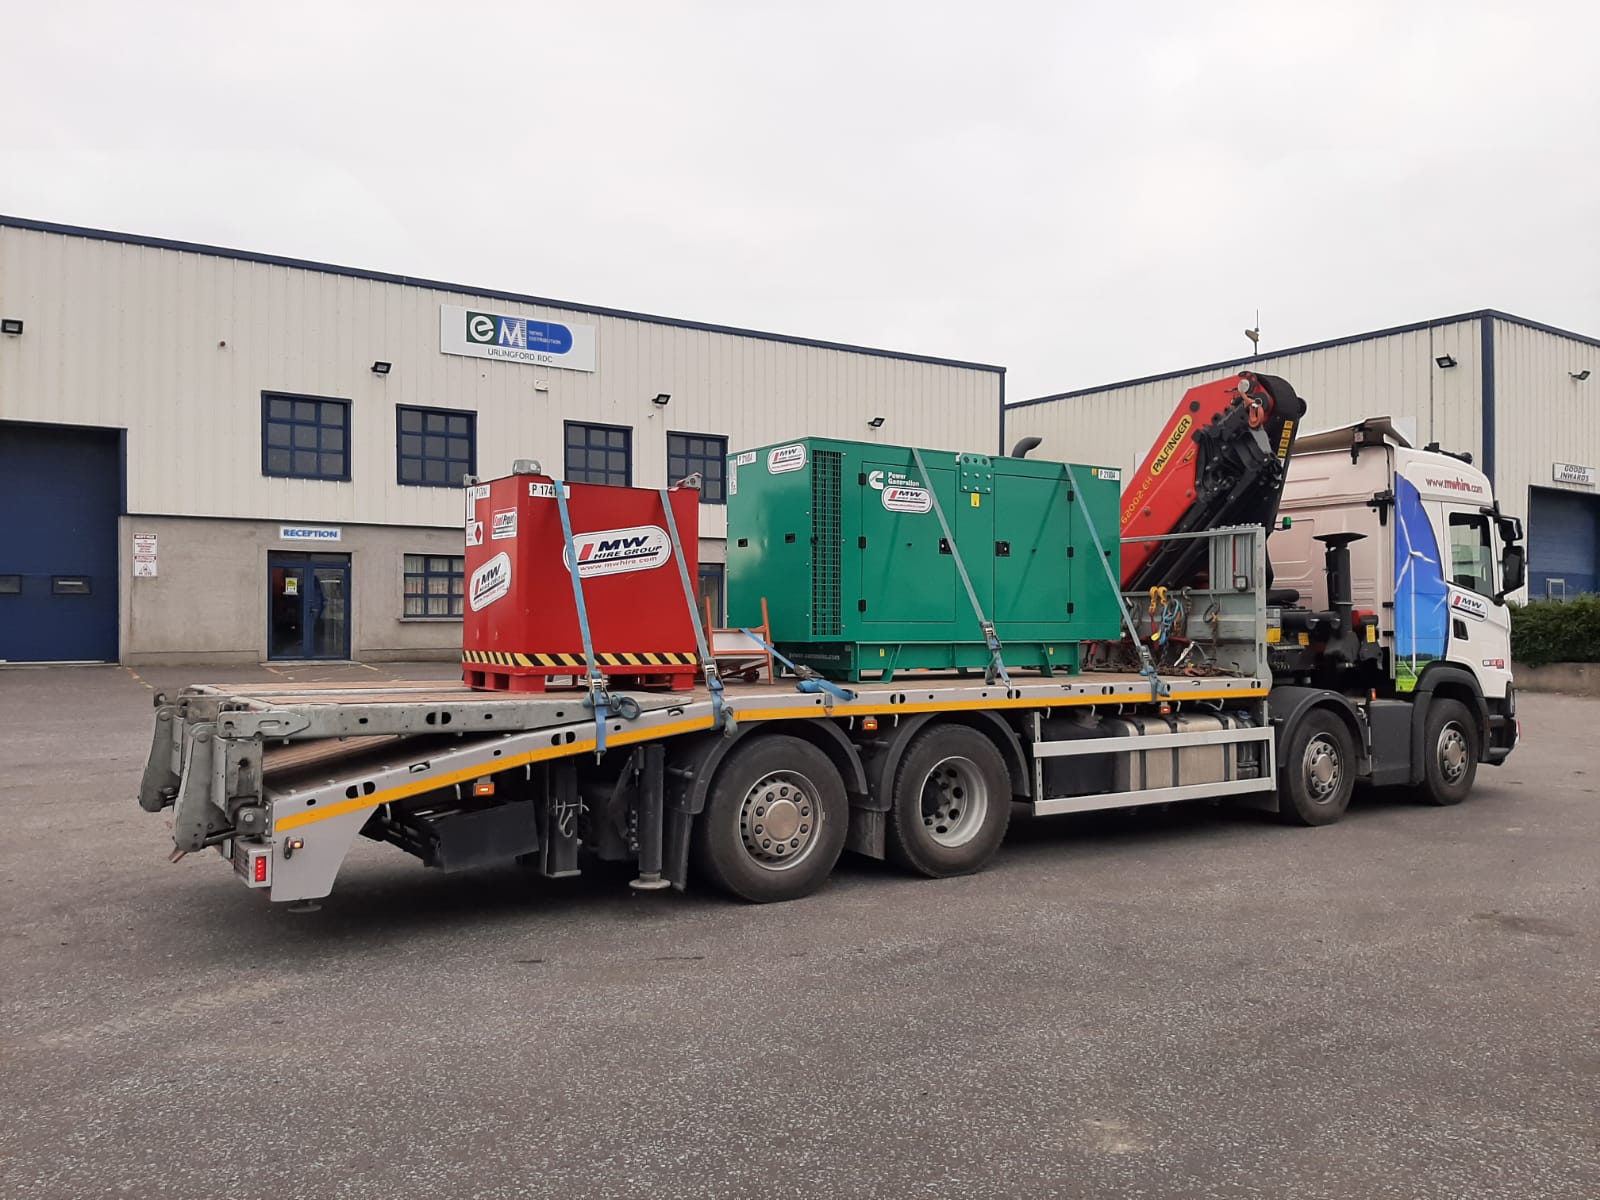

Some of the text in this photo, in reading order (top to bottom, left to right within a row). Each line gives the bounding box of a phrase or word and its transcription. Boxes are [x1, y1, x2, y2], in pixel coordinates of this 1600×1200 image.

[487, 348, 535, 361] URLINGFORD
[1151, 417, 1191, 473] PALFINGER
[779, 448, 798, 457] MW
[887, 471, 907, 480] Power
[1564, 464, 1586, 474] GOODS
[887, 479, 920, 487] Generation
[1560, 471, 1589, 482] INWARDS
[531, 484, 561, 497] P 1741
[1425, 476, 1483, 493] www.mwhire.com
[283, 529, 337, 538] RECEPTION
[598, 535, 650, 552] MW
[593, 545, 663, 560] HIRE GROUP
[580, 556, 658, 571] www.mwhire.com
[481, 562, 502, 585] MW
[1462, 597, 1482, 609] MW
